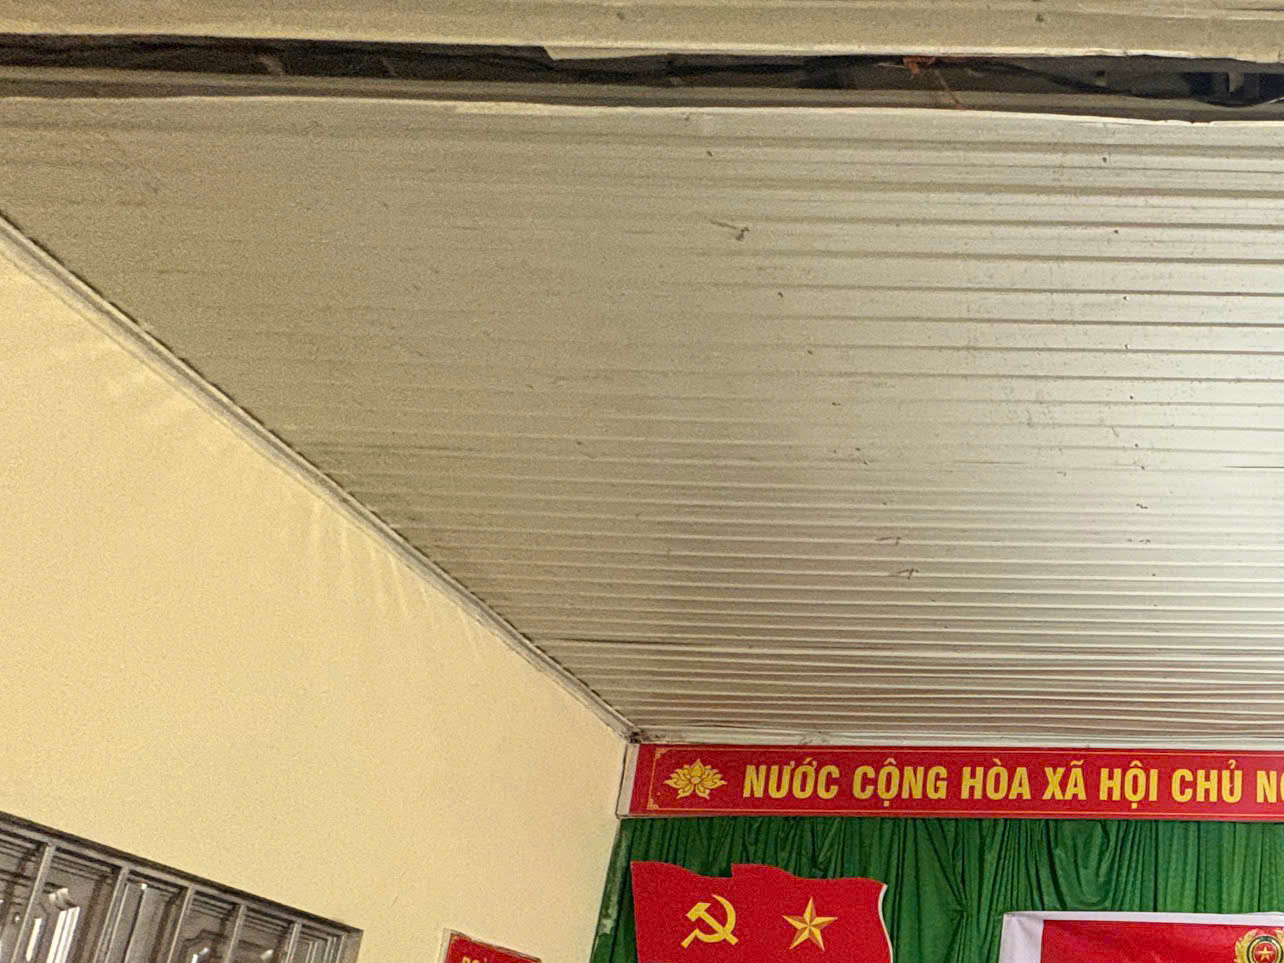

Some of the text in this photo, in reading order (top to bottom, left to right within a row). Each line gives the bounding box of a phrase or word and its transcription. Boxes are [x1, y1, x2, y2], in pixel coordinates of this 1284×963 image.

[743, 756, 839, 799] NƯỚC
[852, 757, 949, 807] CỘNG
[961, 757, 1031, 801] HÒA
[1041, 761, 1087, 801] XÃ
[1100, 758, 1159, 809] HỘI
[1171, 760, 1243, 804] CHỦ
